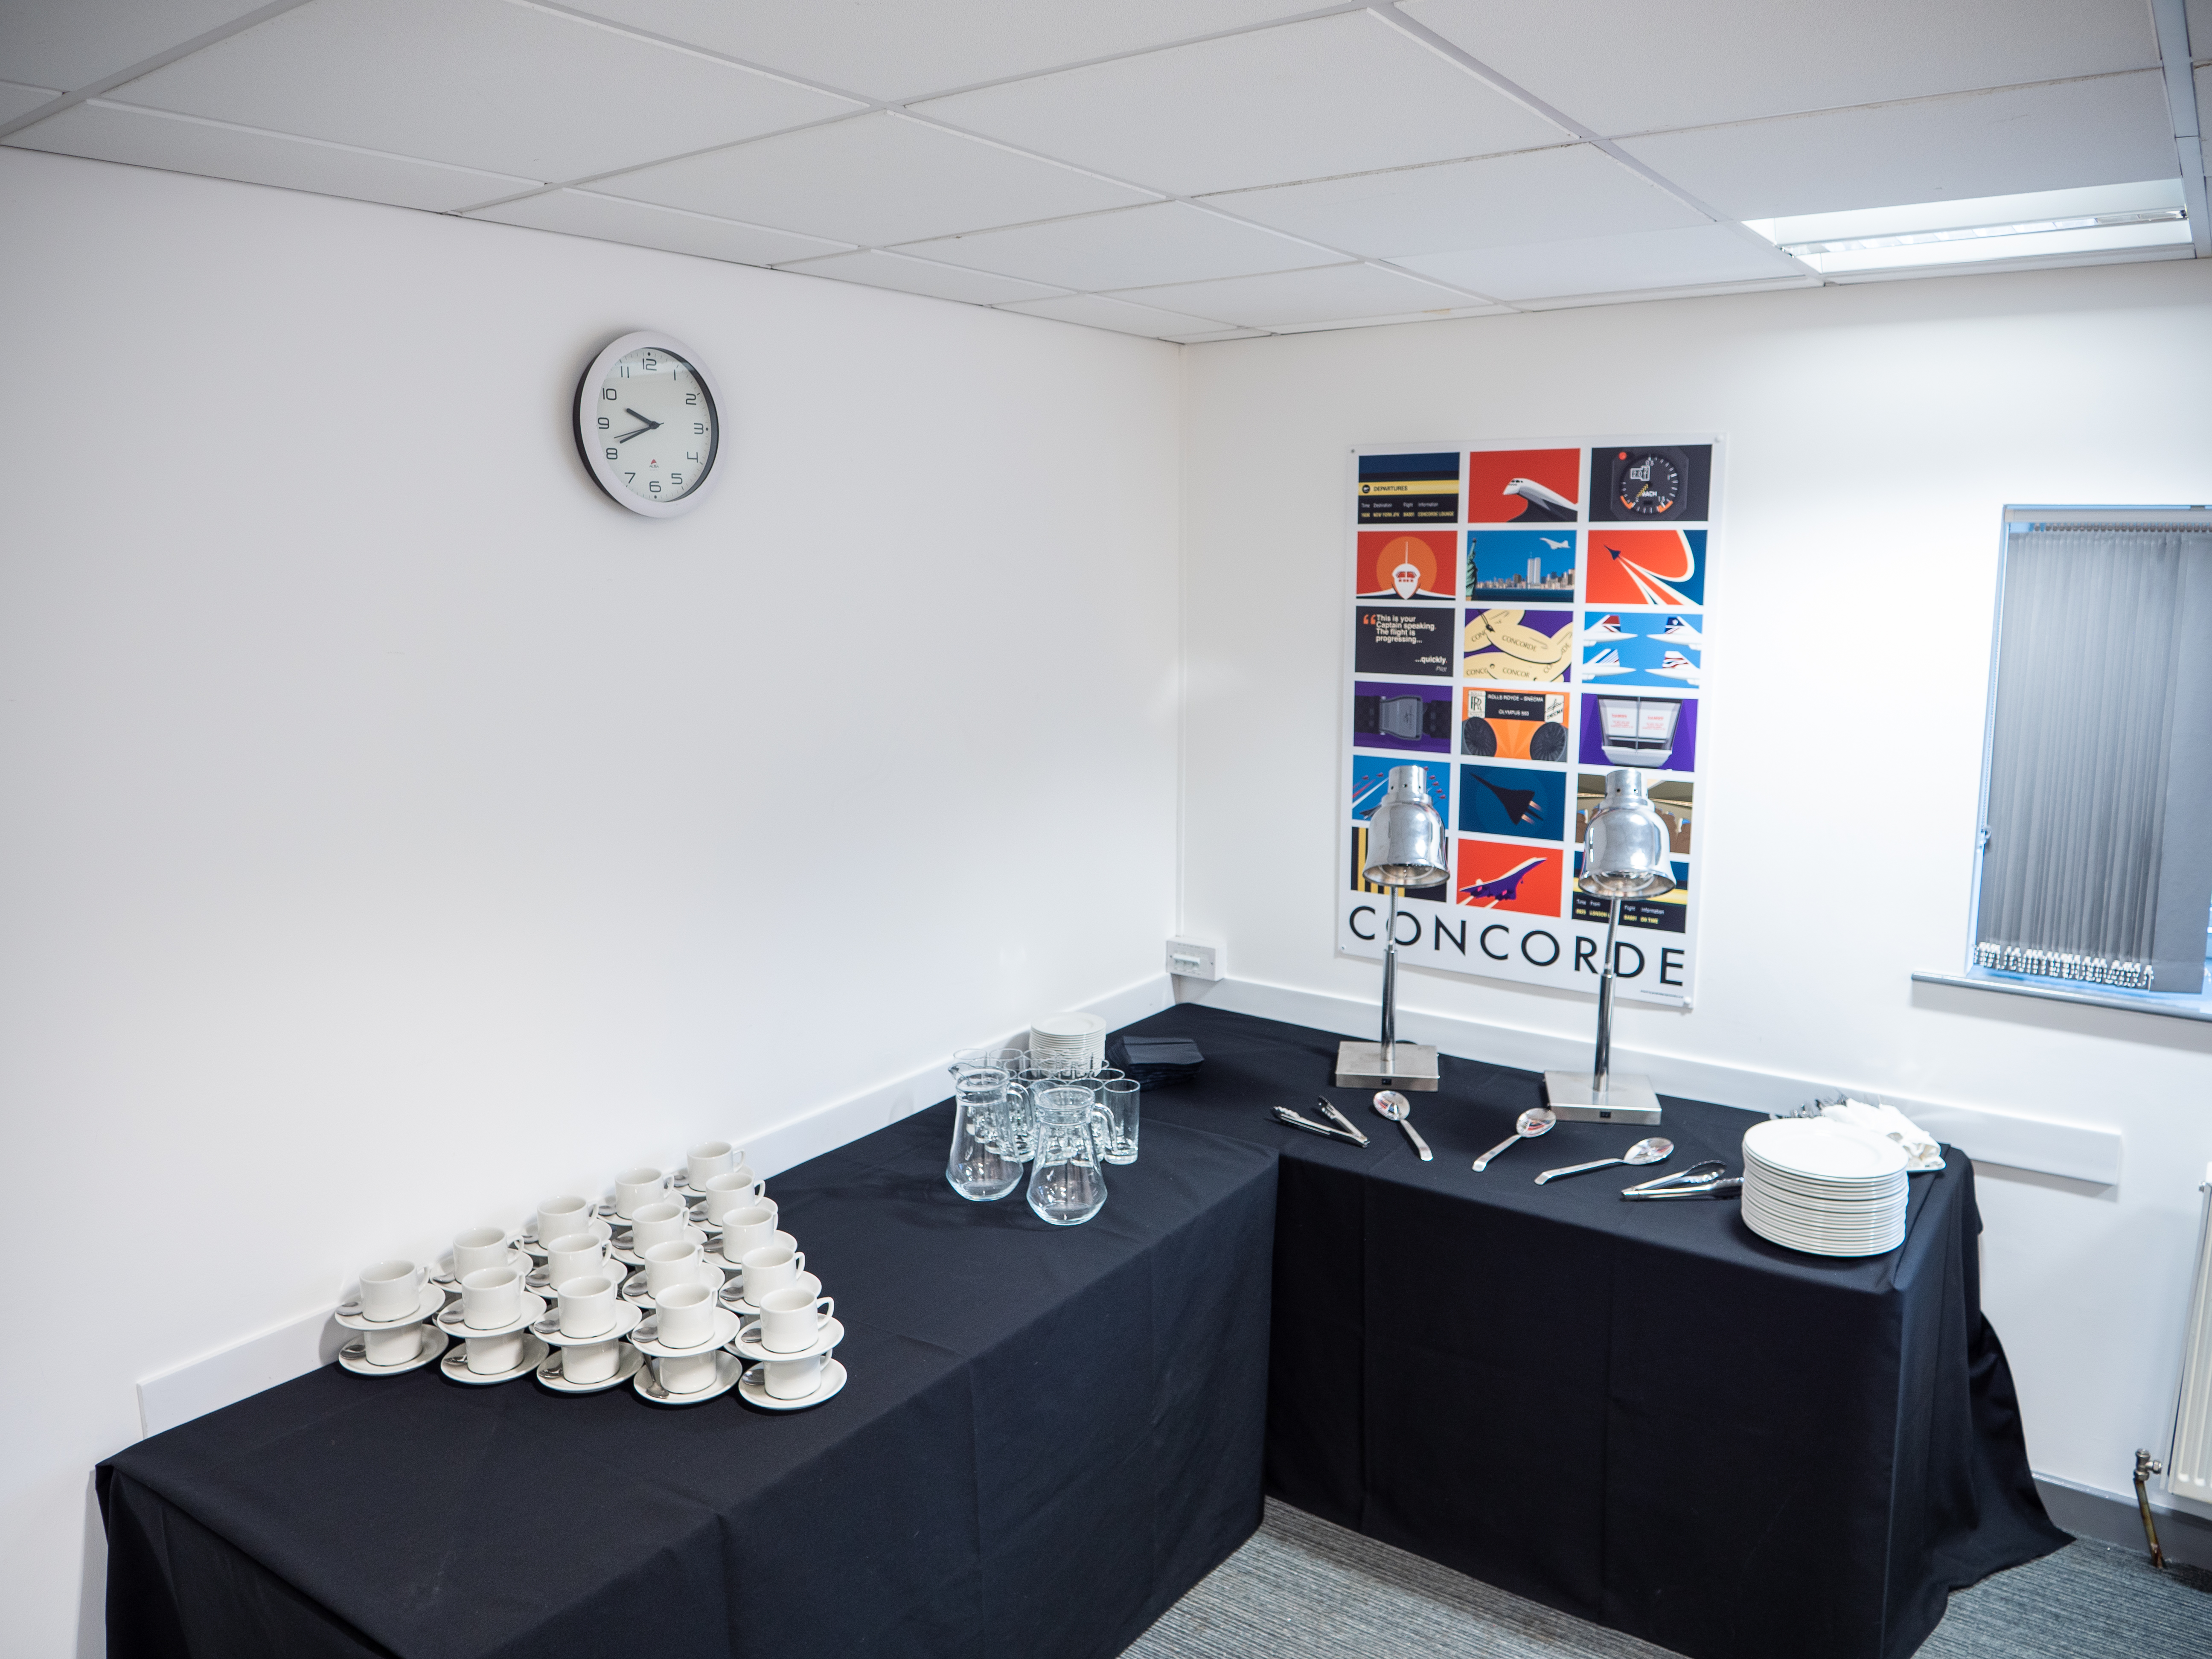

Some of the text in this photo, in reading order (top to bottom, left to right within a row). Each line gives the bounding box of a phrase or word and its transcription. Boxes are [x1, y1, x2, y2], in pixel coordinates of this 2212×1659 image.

[642, 358, 657, 371] 12
[620, 366, 629, 378] 11
[602, 388, 617, 400] 10
[685, 393, 697, 405] 2
[597, 417, 610, 429] 9
[694, 422, 704, 434] 3
[606, 448, 618, 460] 8
[687, 451, 699, 463] 4
[624, 472, 636, 484] 7
[671, 473, 683, 485] 5
[649, 481, 661, 493] 6
[1390, 629, 1409, 637] flight
[1502, 634, 1537, 652] CONCORDE
[1349, 905, 1685, 986] CONCORDE
